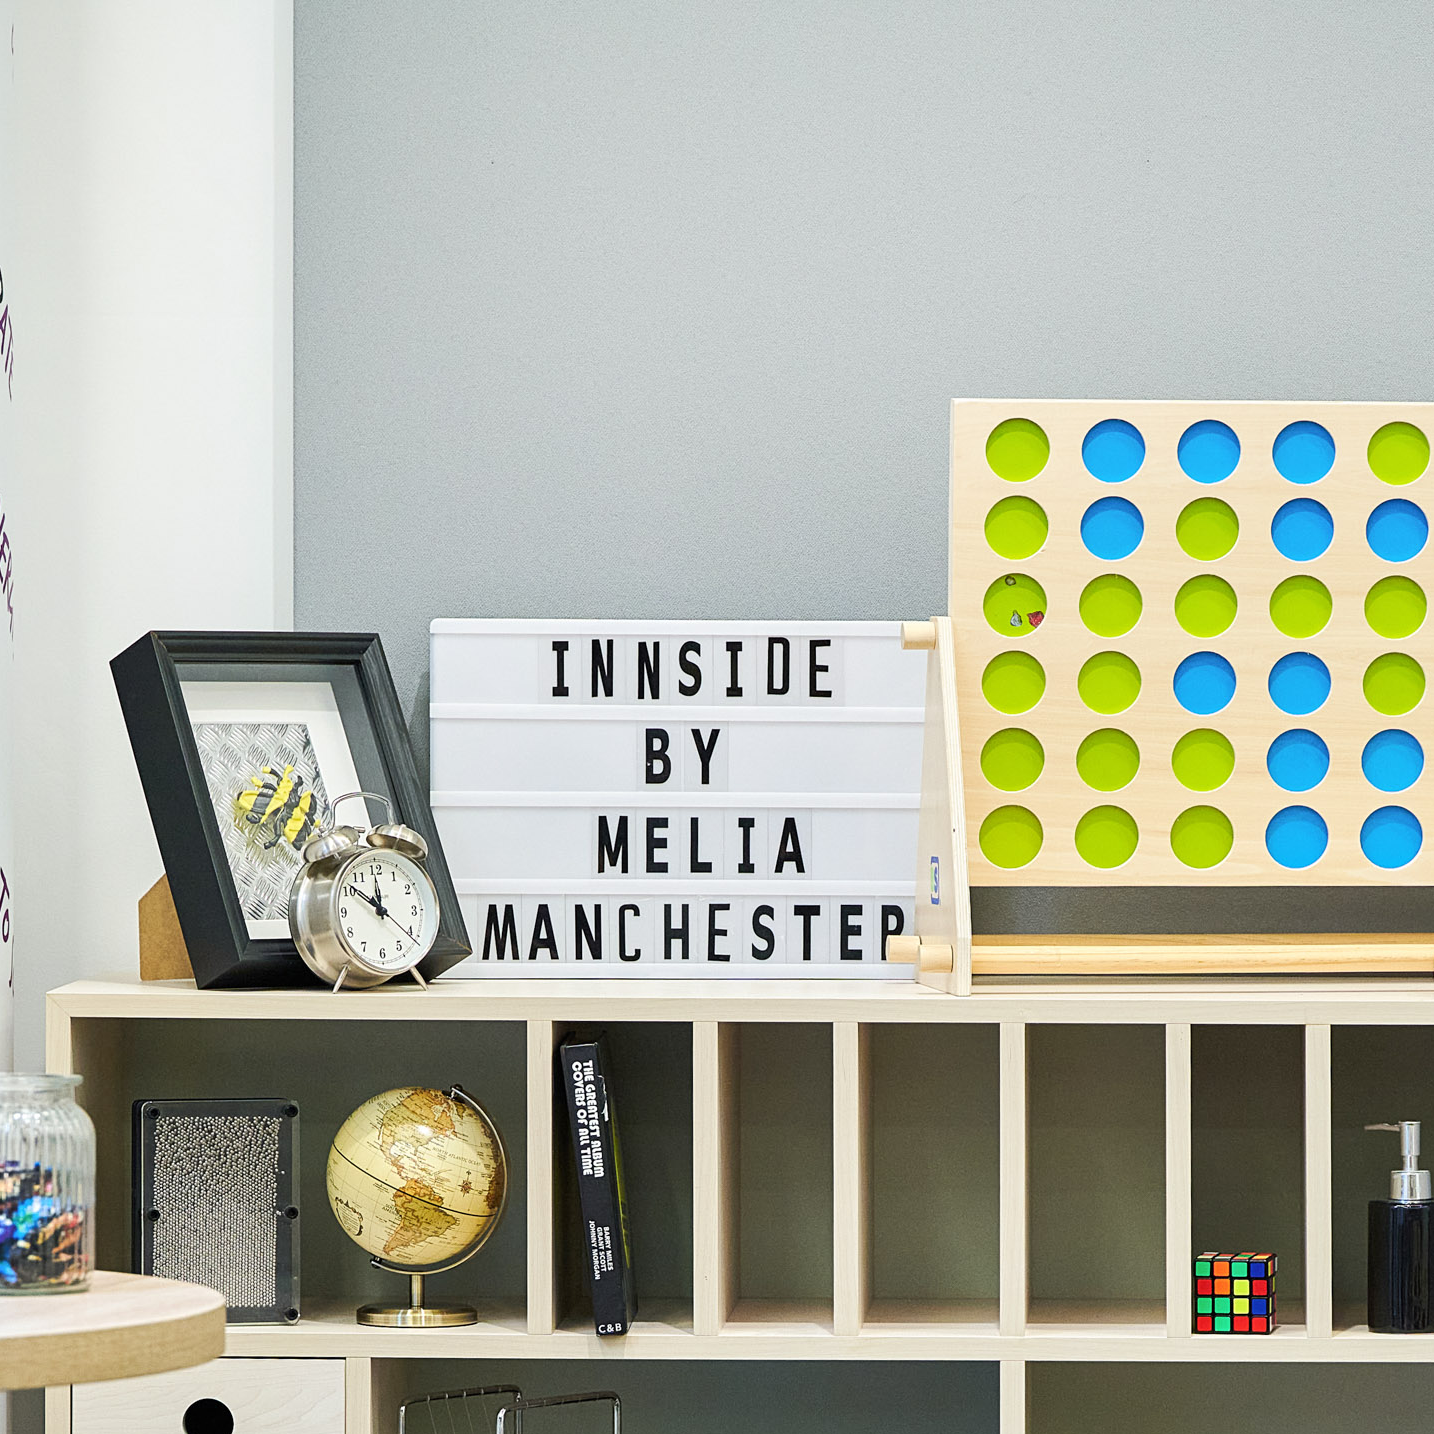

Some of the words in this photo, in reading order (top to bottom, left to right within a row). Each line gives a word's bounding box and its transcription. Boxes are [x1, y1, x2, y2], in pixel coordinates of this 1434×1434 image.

[551, 636, 834, 700] INNSIDE
[645, 728, 721, 785] BY
[597, 815, 807, 874] MELIA
[352, 872, 365, 883] 11
[369, 864, 383, 876] 12
[390, 871, 396, 882] 1
[342, 886, 356, 897] 10
[404, 884, 411, 895] 2
[340, 908, 348, 919] 9
[411, 905, 418, 916] 3
[346, 927, 354, 938] 8
[360, 941, 367, 953] 7
[379, 948, 386, 959] 6
[396, 940, 403, 952] 5
[582, 1060, 595, 1082] THE
[571, 1061, 586, 1107] COVERS
[576, 1109, 588, 1126] OF
[585, 1084, 601, 1138] GREATEST
[578, 1128, 590, 1146] ALL
[580, 1147, 593, 1176] TIME
[591, 1140, 605, 1178] ALBUM
[588, 1220, 598, 1248] JOHNNY
[596, 1227, 605, 1250] GRANT
[603, 1226, 612, 1249] BARRY
[591, 1249, 601, 1280] MORGAN
[599, 1251, 607, 1272] SCOTT
[605, 1250, 614, 1271] MILES
